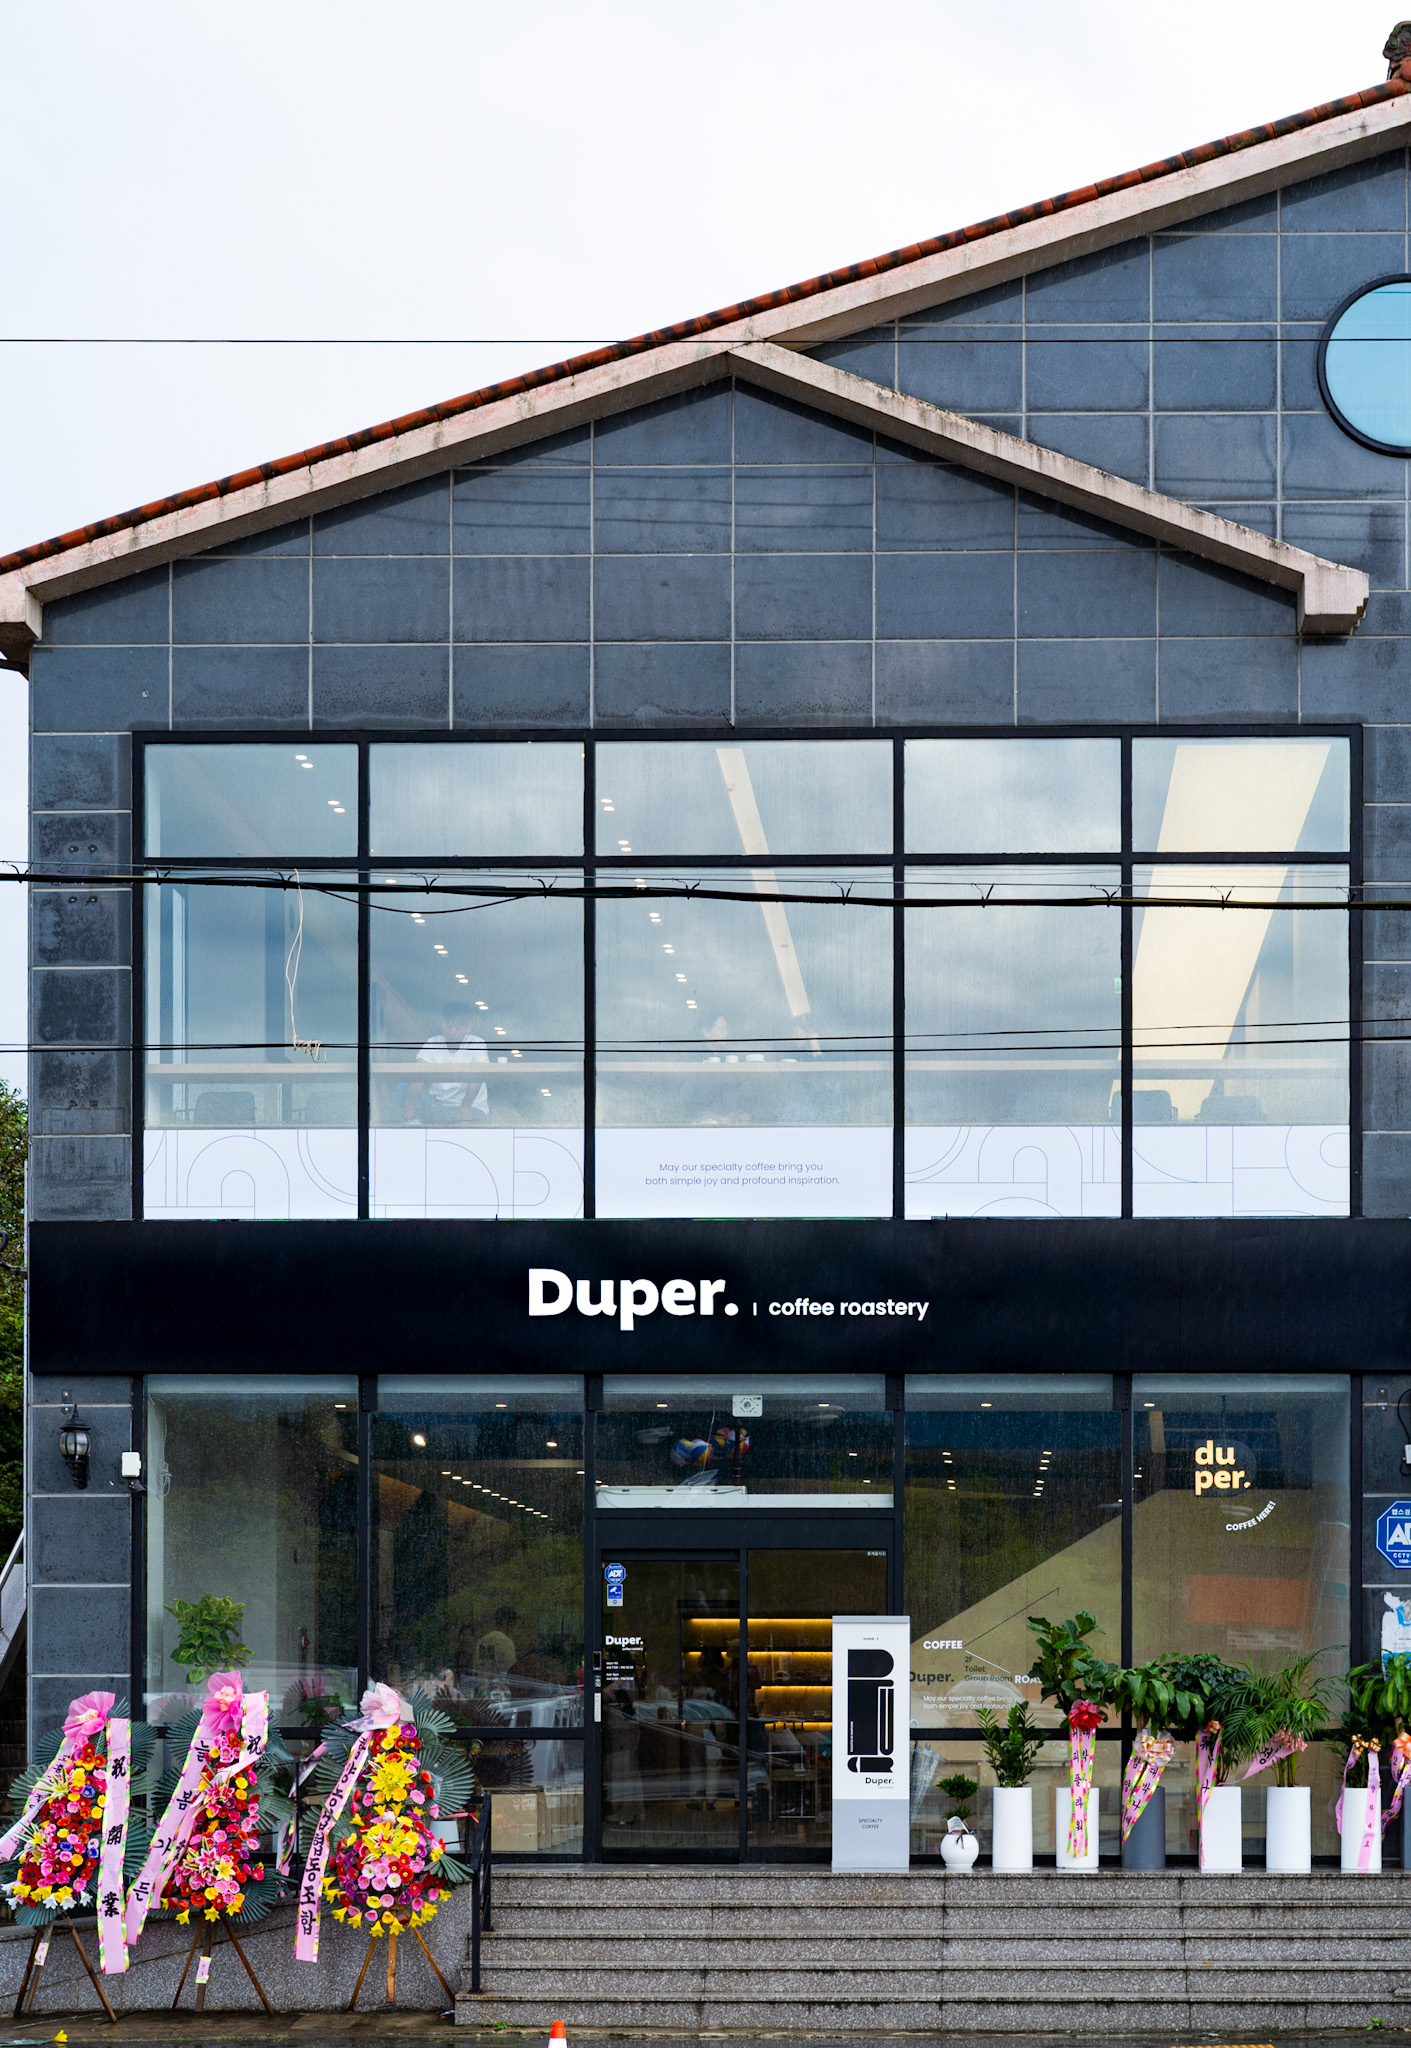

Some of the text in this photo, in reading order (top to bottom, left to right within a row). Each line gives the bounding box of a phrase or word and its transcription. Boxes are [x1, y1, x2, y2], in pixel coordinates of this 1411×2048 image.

[659, 1162, 823, 1173] May our specialty coffee bring you
[645, 1175, 840, 1187] both simple joy and profound inspiration.
[528, 1268, 929, 1331] Duper. coffee roastery
[1195, 1440, 1236, 1465] du
[1195, 1470, 1251, 1496] per.
[1225, 1500, 1276, 1531] COFFEE HERE!
[608, 1570, 623, 1578] ADT
[605, 1635, 644, 1648] Duper.
[923, 1640, 963, 1650] COFFEE
[964, 1665, 986, 1673] Toilet
[964, 1675, 1013, 1684] Group Room
[923, 1695, 937, 1703] May
[948, 1695, 976, 1703] specialty
[938, 1703, 959, 1711] simple
[959, 1703, 969, 1711] joy
[865, 1777, 895, 1786] Duper.
